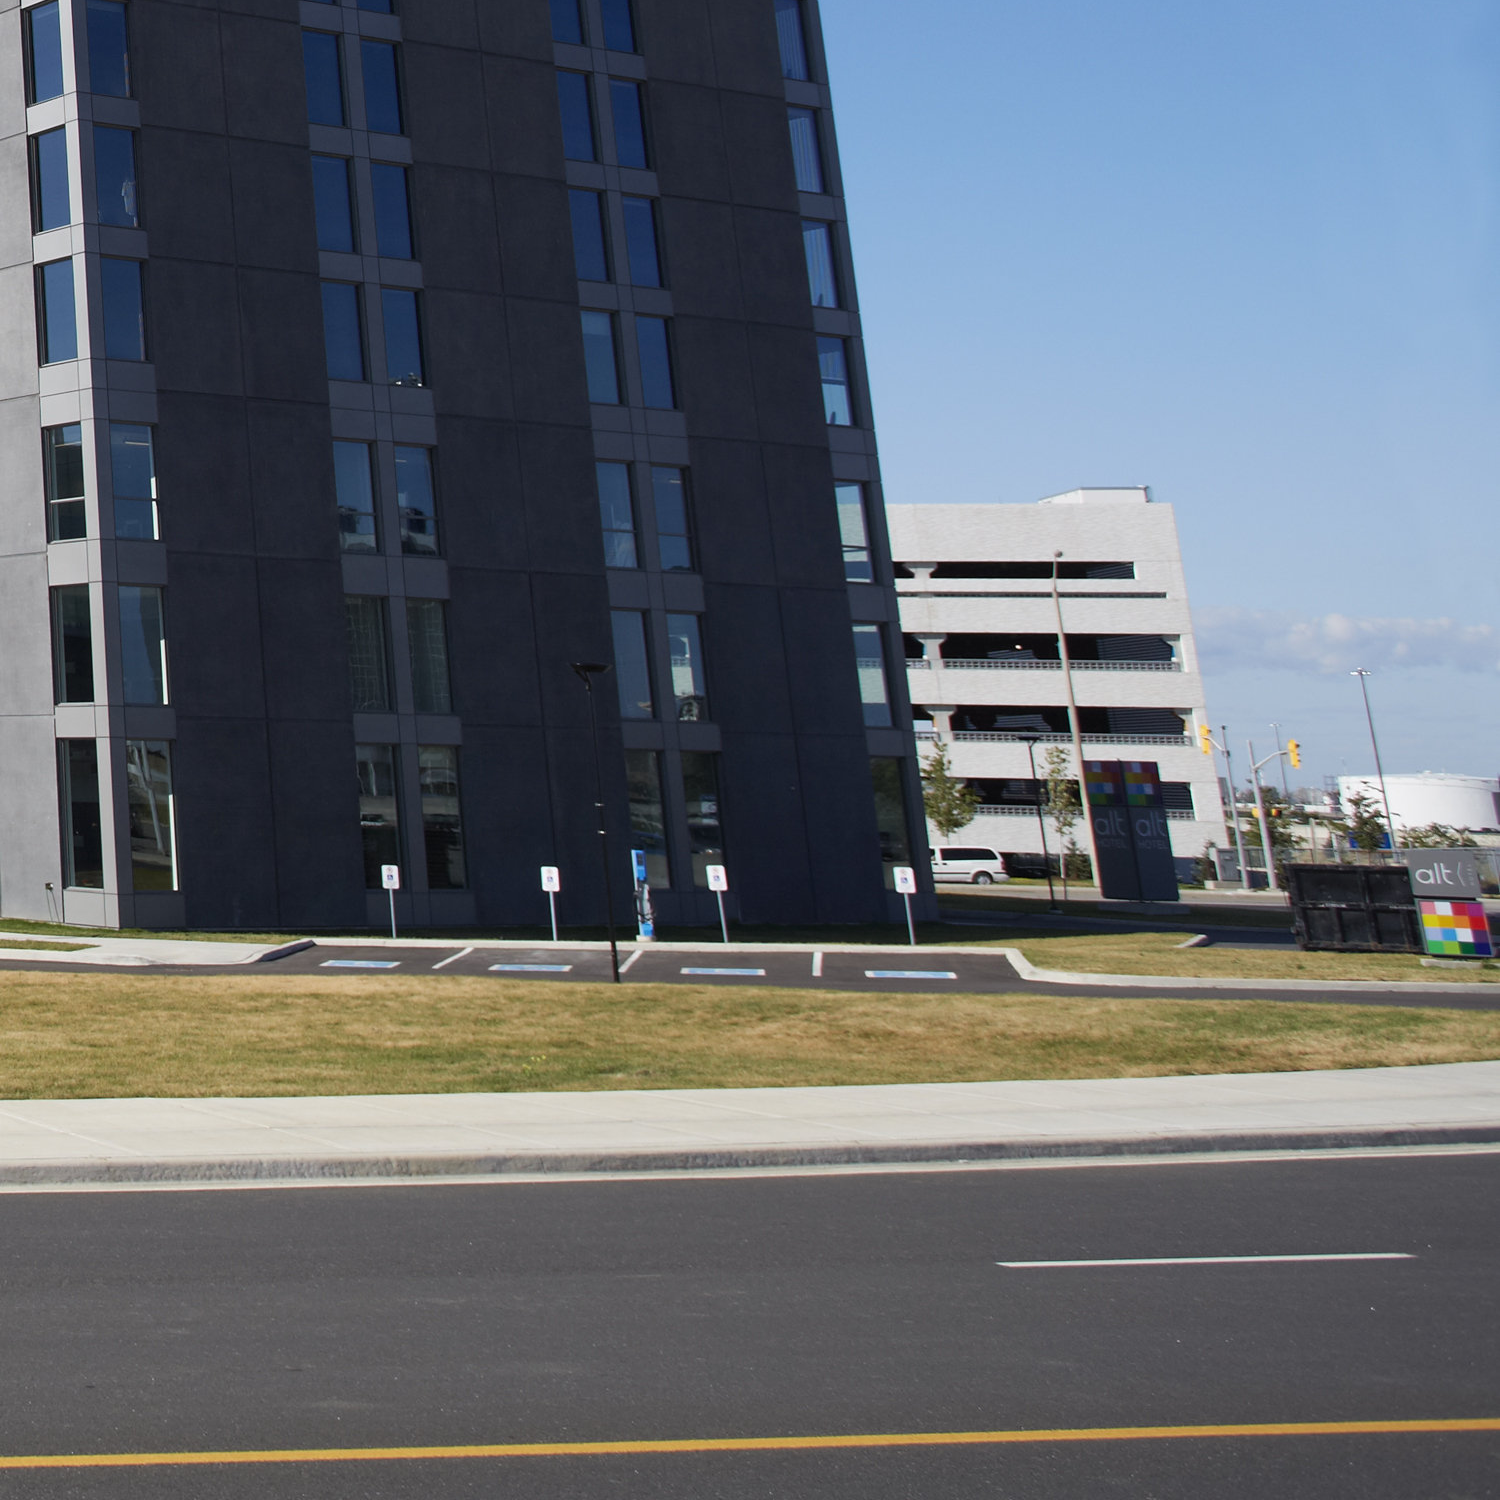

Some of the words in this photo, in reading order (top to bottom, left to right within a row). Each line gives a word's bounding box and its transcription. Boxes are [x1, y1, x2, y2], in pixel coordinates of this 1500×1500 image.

[1095, 810, 1127, 836] alt
[1136, 811, 1168, 837] alt
[1415, 862, 1454, 885] alt
